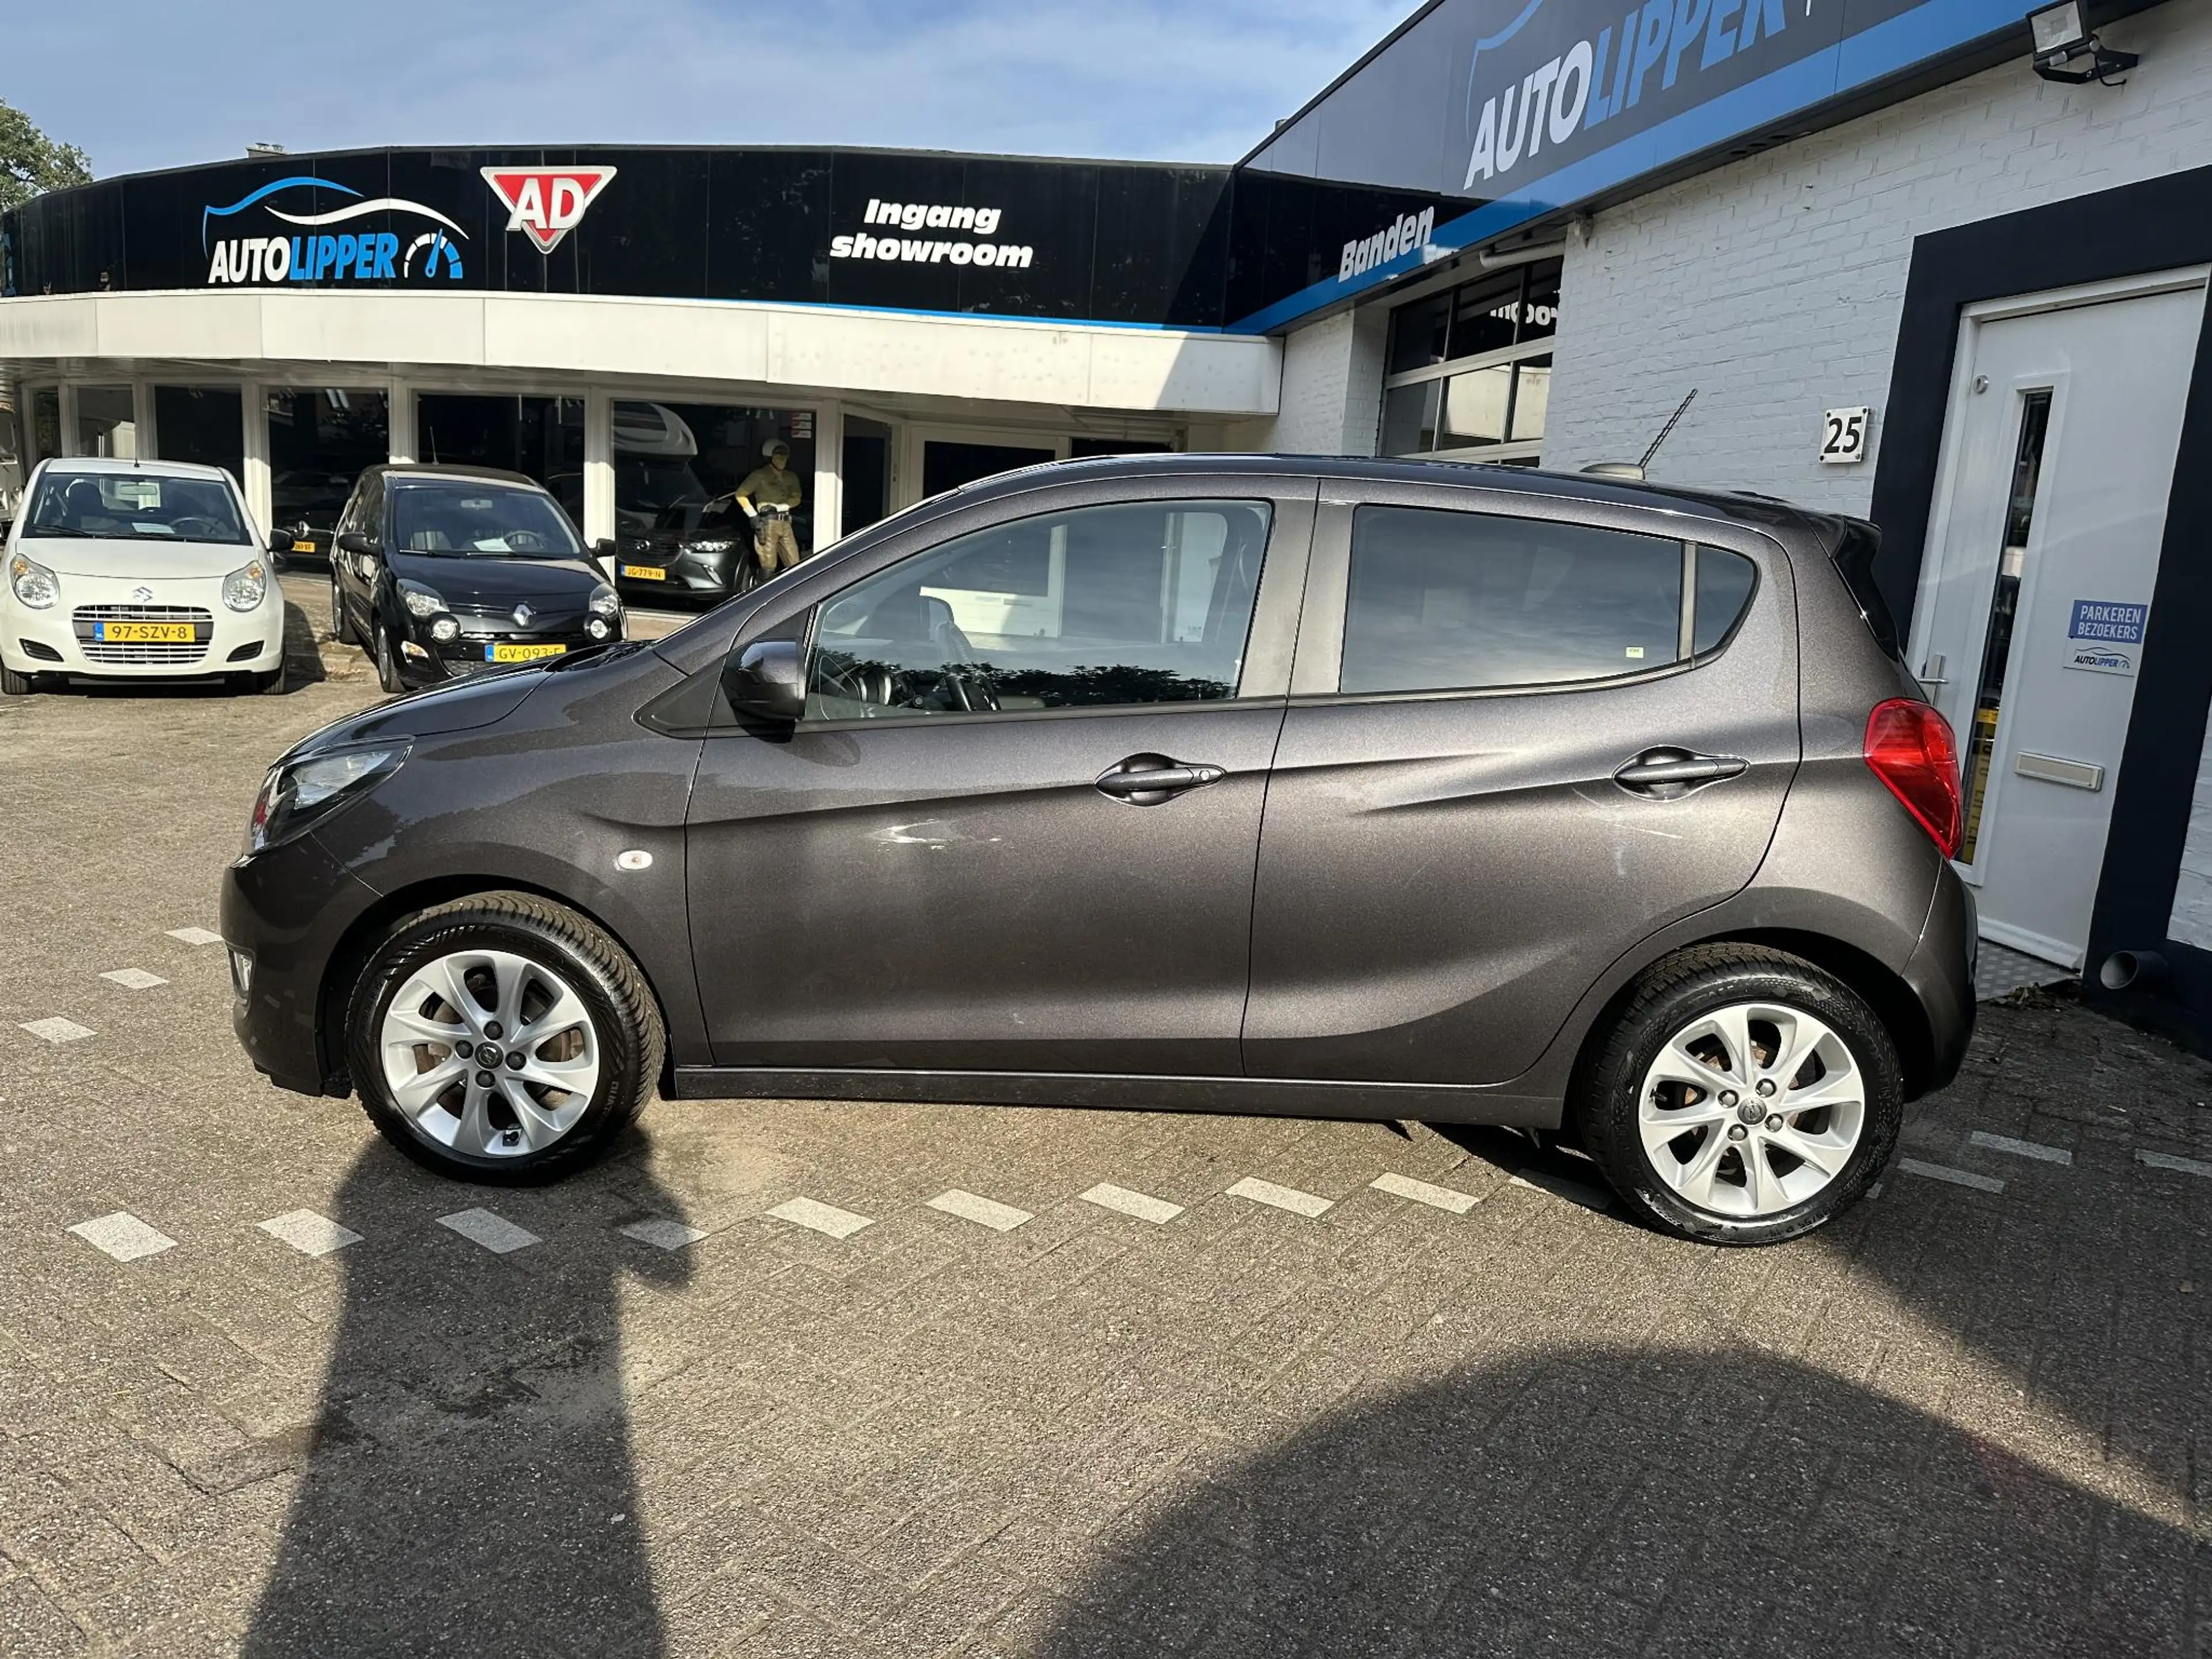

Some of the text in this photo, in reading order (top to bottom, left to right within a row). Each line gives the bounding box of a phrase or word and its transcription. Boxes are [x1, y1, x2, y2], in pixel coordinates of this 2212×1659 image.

[506, 177, 585, 231] AD
[863, 199, 1002, 234] Ingang
[208, 233, 399, 283] AUTOLIPPER
[830, 232, 1033, 268] showroom
[1338, 206, 1434, 283] Banden
[1824, 416, 1862, 453] 25
[2077, 622, 2138, 640] BEZOEKERS
[2080, 605, 2142, 623] PARKEREN
[112, 626, 187, 639] 97-SZV-8
[2074, 656, 2119, 667] AUTOLIPPER
